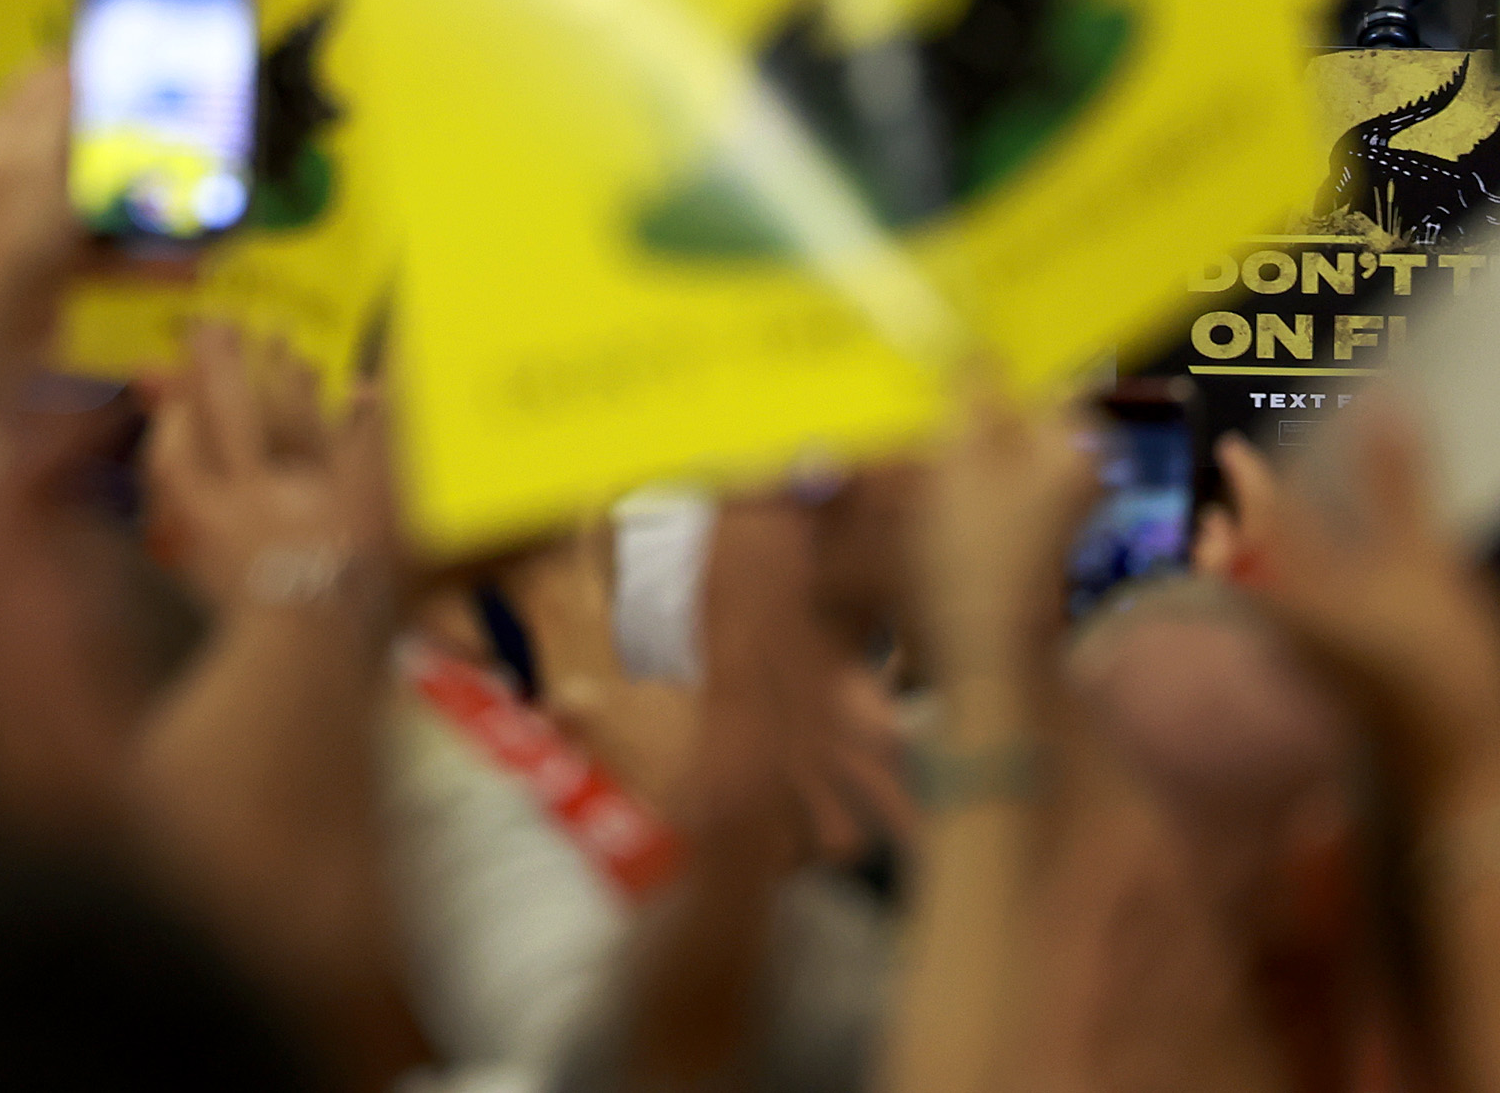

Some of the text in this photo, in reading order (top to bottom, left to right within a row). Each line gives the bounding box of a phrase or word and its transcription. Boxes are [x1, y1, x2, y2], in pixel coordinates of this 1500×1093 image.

[1188, 250, 1428, 295] DON'T
[1191, 311, 1313, 360] ON
[1250, 393, 1326, 408] TEXT
